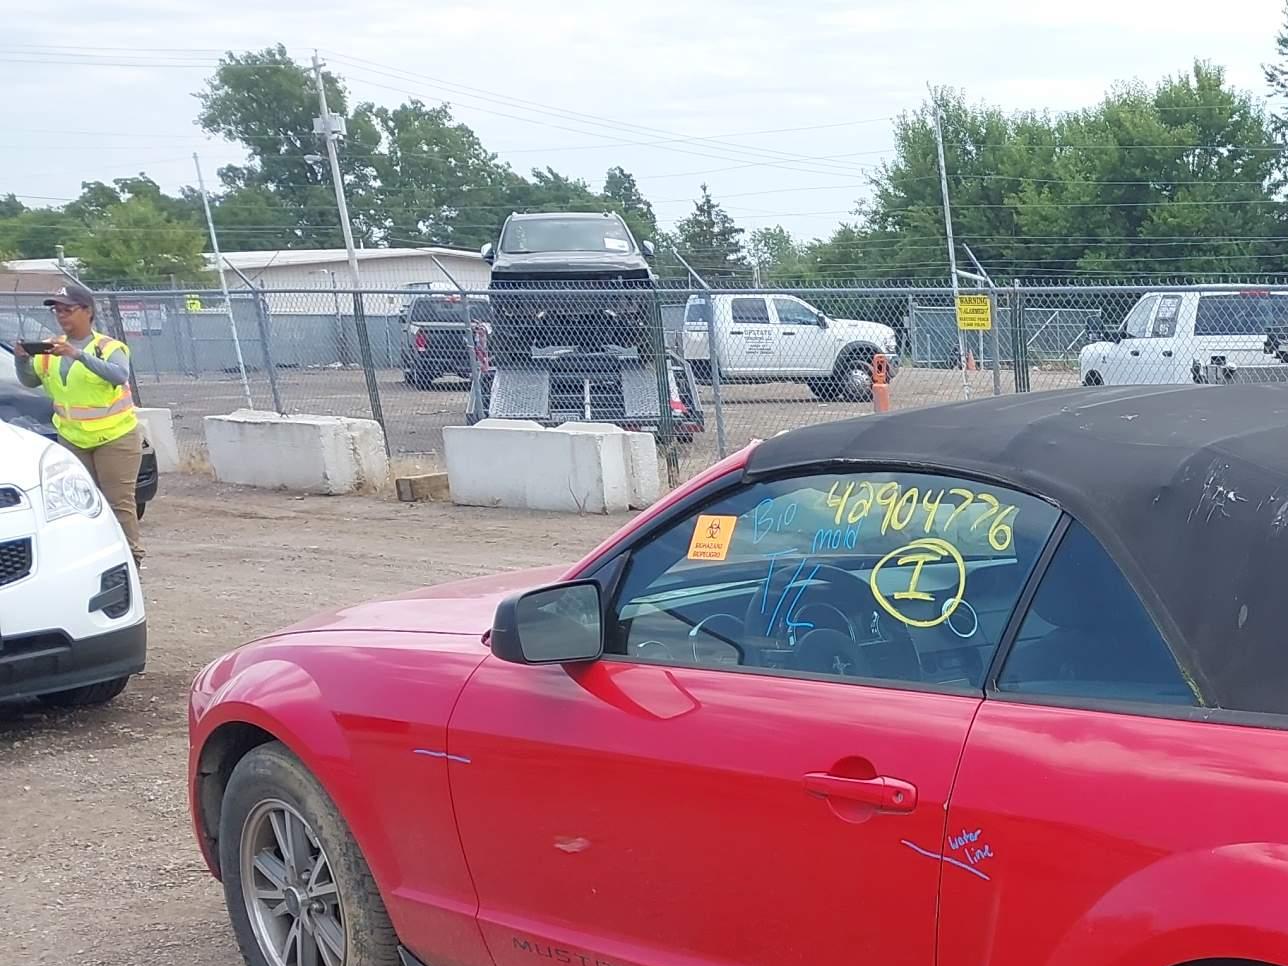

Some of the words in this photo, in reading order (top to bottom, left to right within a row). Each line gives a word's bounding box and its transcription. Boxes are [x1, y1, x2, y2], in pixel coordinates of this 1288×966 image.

[959, 297, 988, 305] WARNING
[826, 480, 1015, 550] 42904776
[964, 844, 994, 865] line
